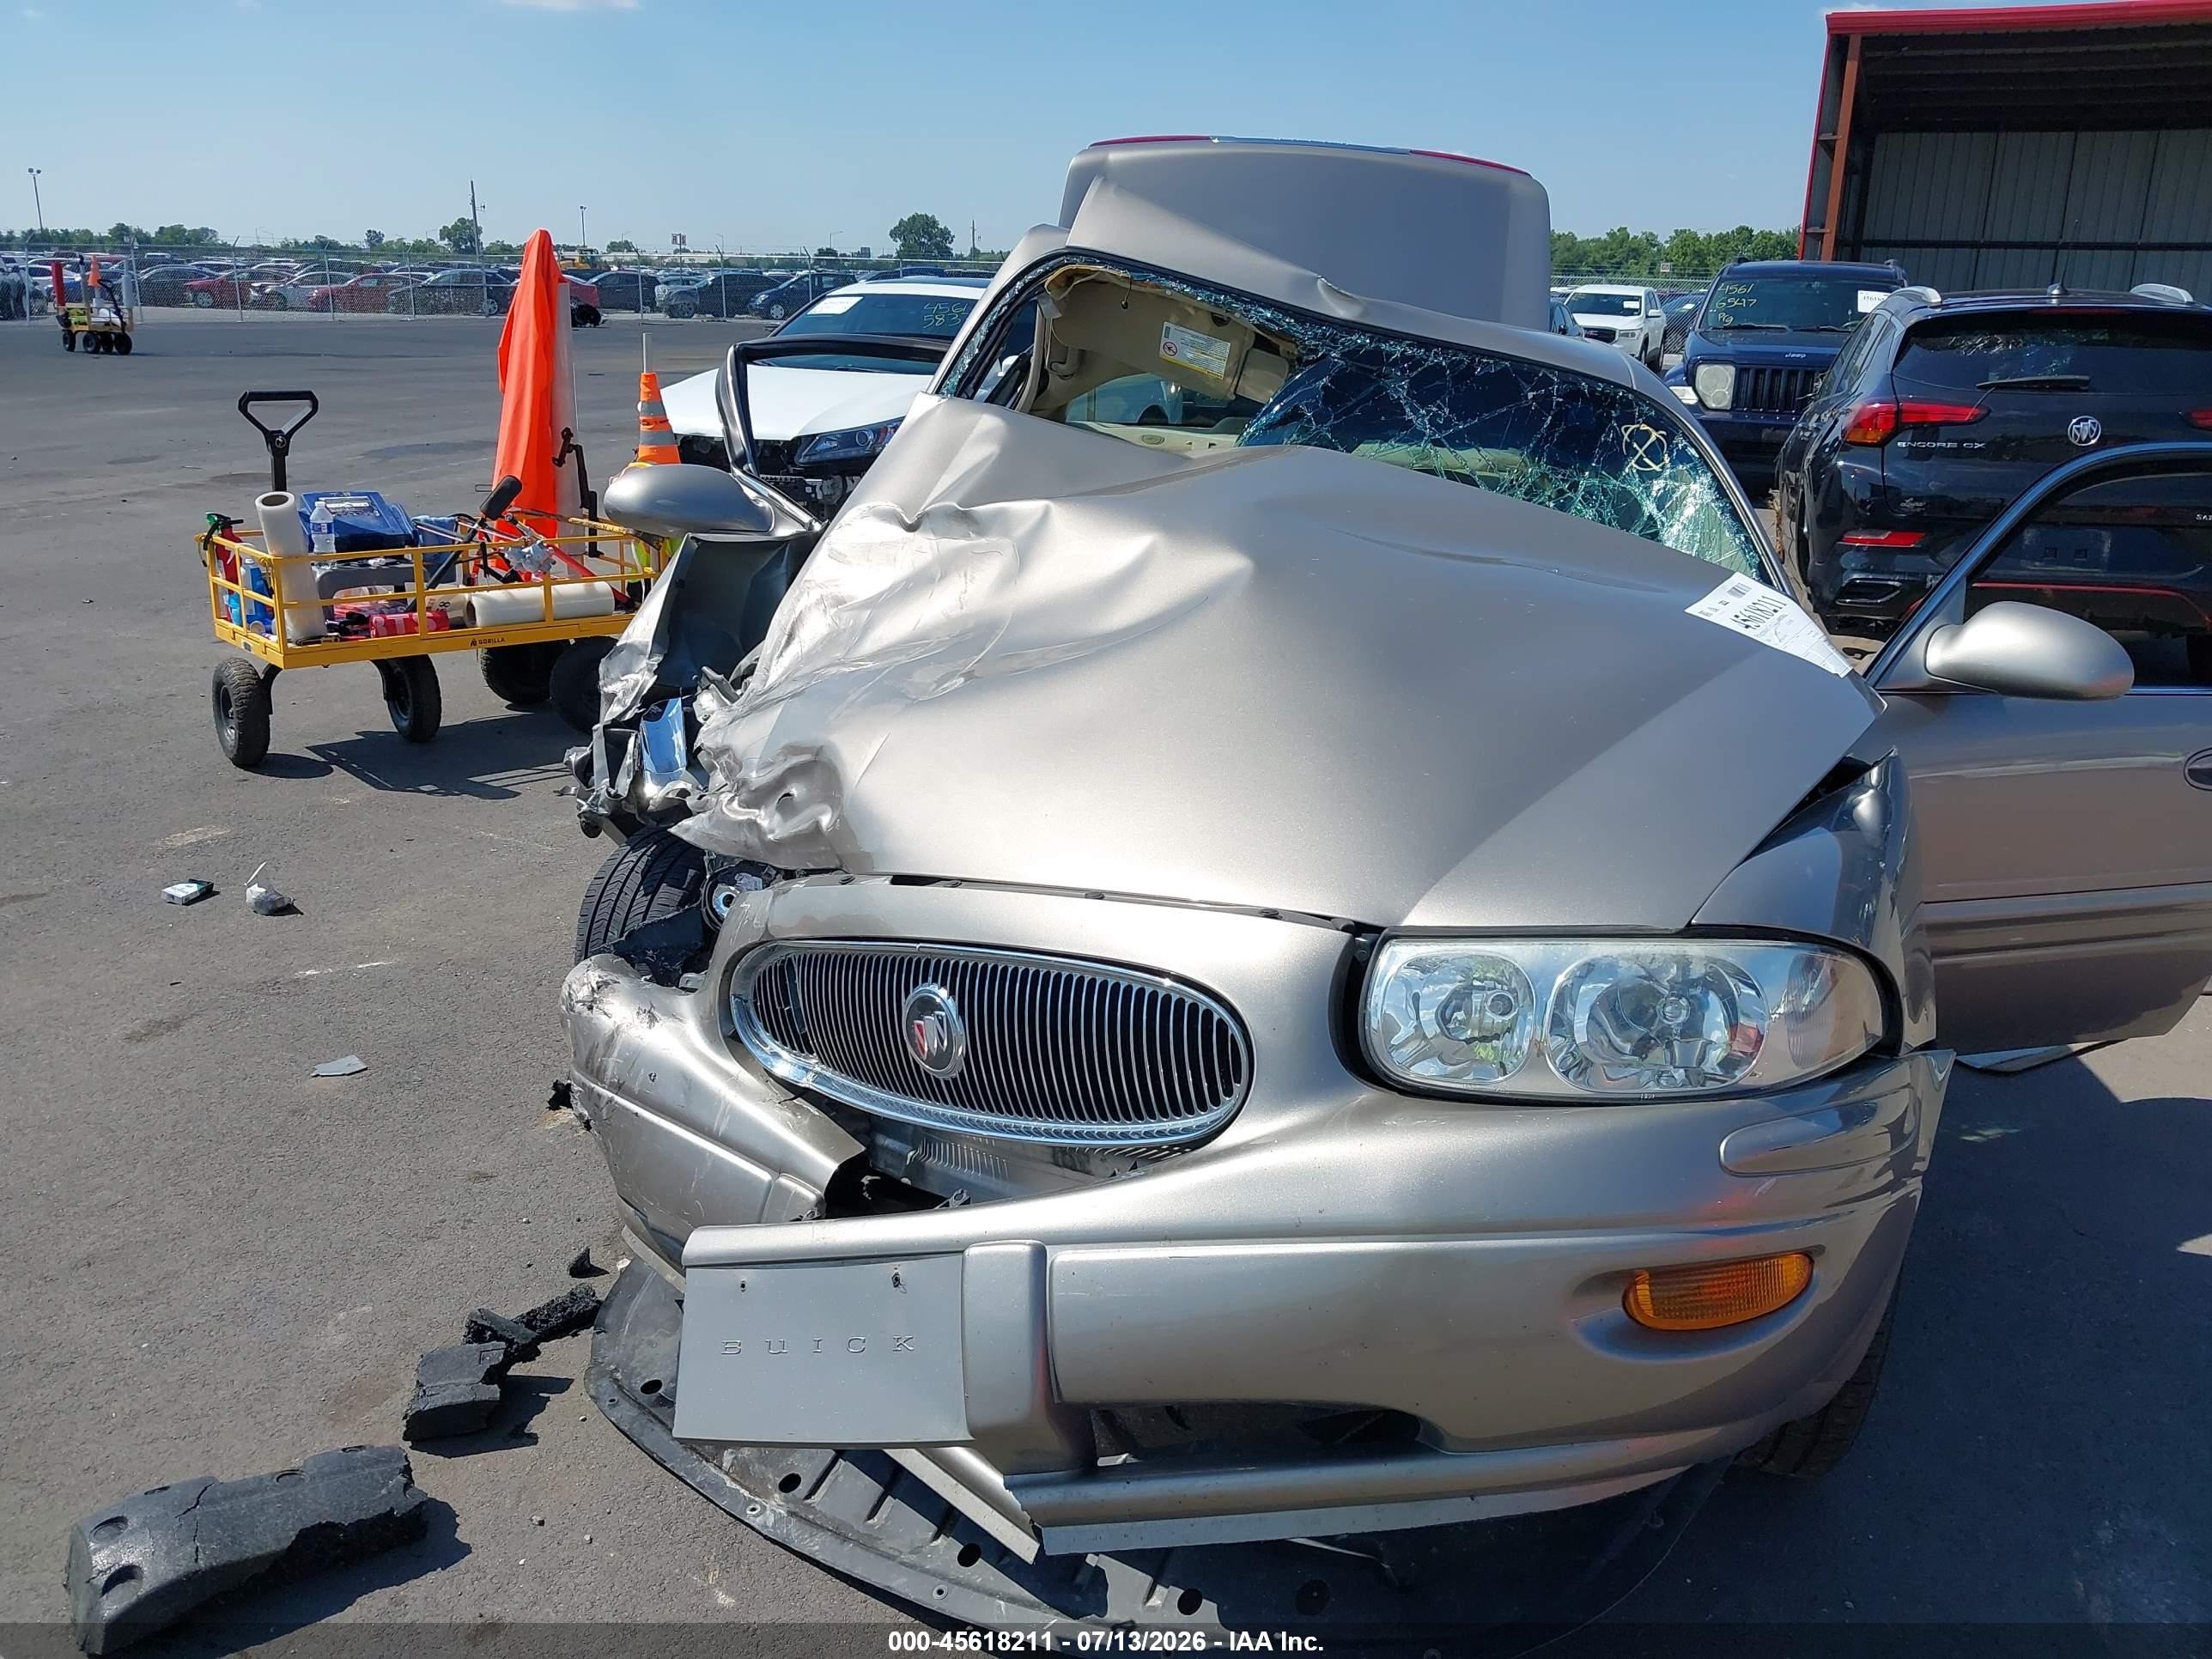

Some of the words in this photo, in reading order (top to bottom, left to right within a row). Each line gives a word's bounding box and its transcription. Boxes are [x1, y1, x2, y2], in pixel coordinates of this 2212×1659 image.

[1717, 283, 1754, 295] 4561
[923, 302, 969, 314] 4561
[1716, 297, 1757, 309] 6547
[923, 312, 969, 329] 583
[1729, 595, 1787, 630] 45618211
[720, 1334, 915, 1355] BUICK
